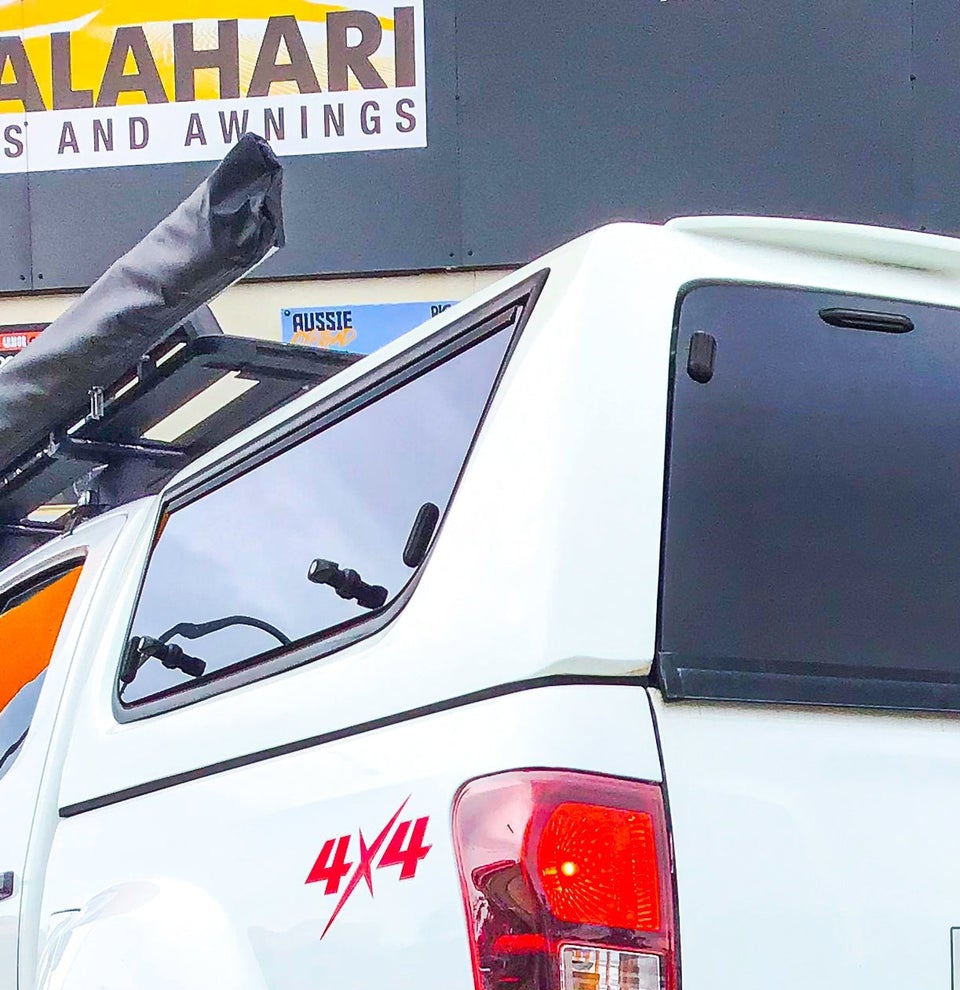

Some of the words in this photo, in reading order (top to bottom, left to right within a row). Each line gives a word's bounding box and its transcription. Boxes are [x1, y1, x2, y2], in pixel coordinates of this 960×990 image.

[58, 116, 150, 154] AND
[184, 98, 417, 147] AWNINGS
[292, 311, 353, 332] AUSSIE
